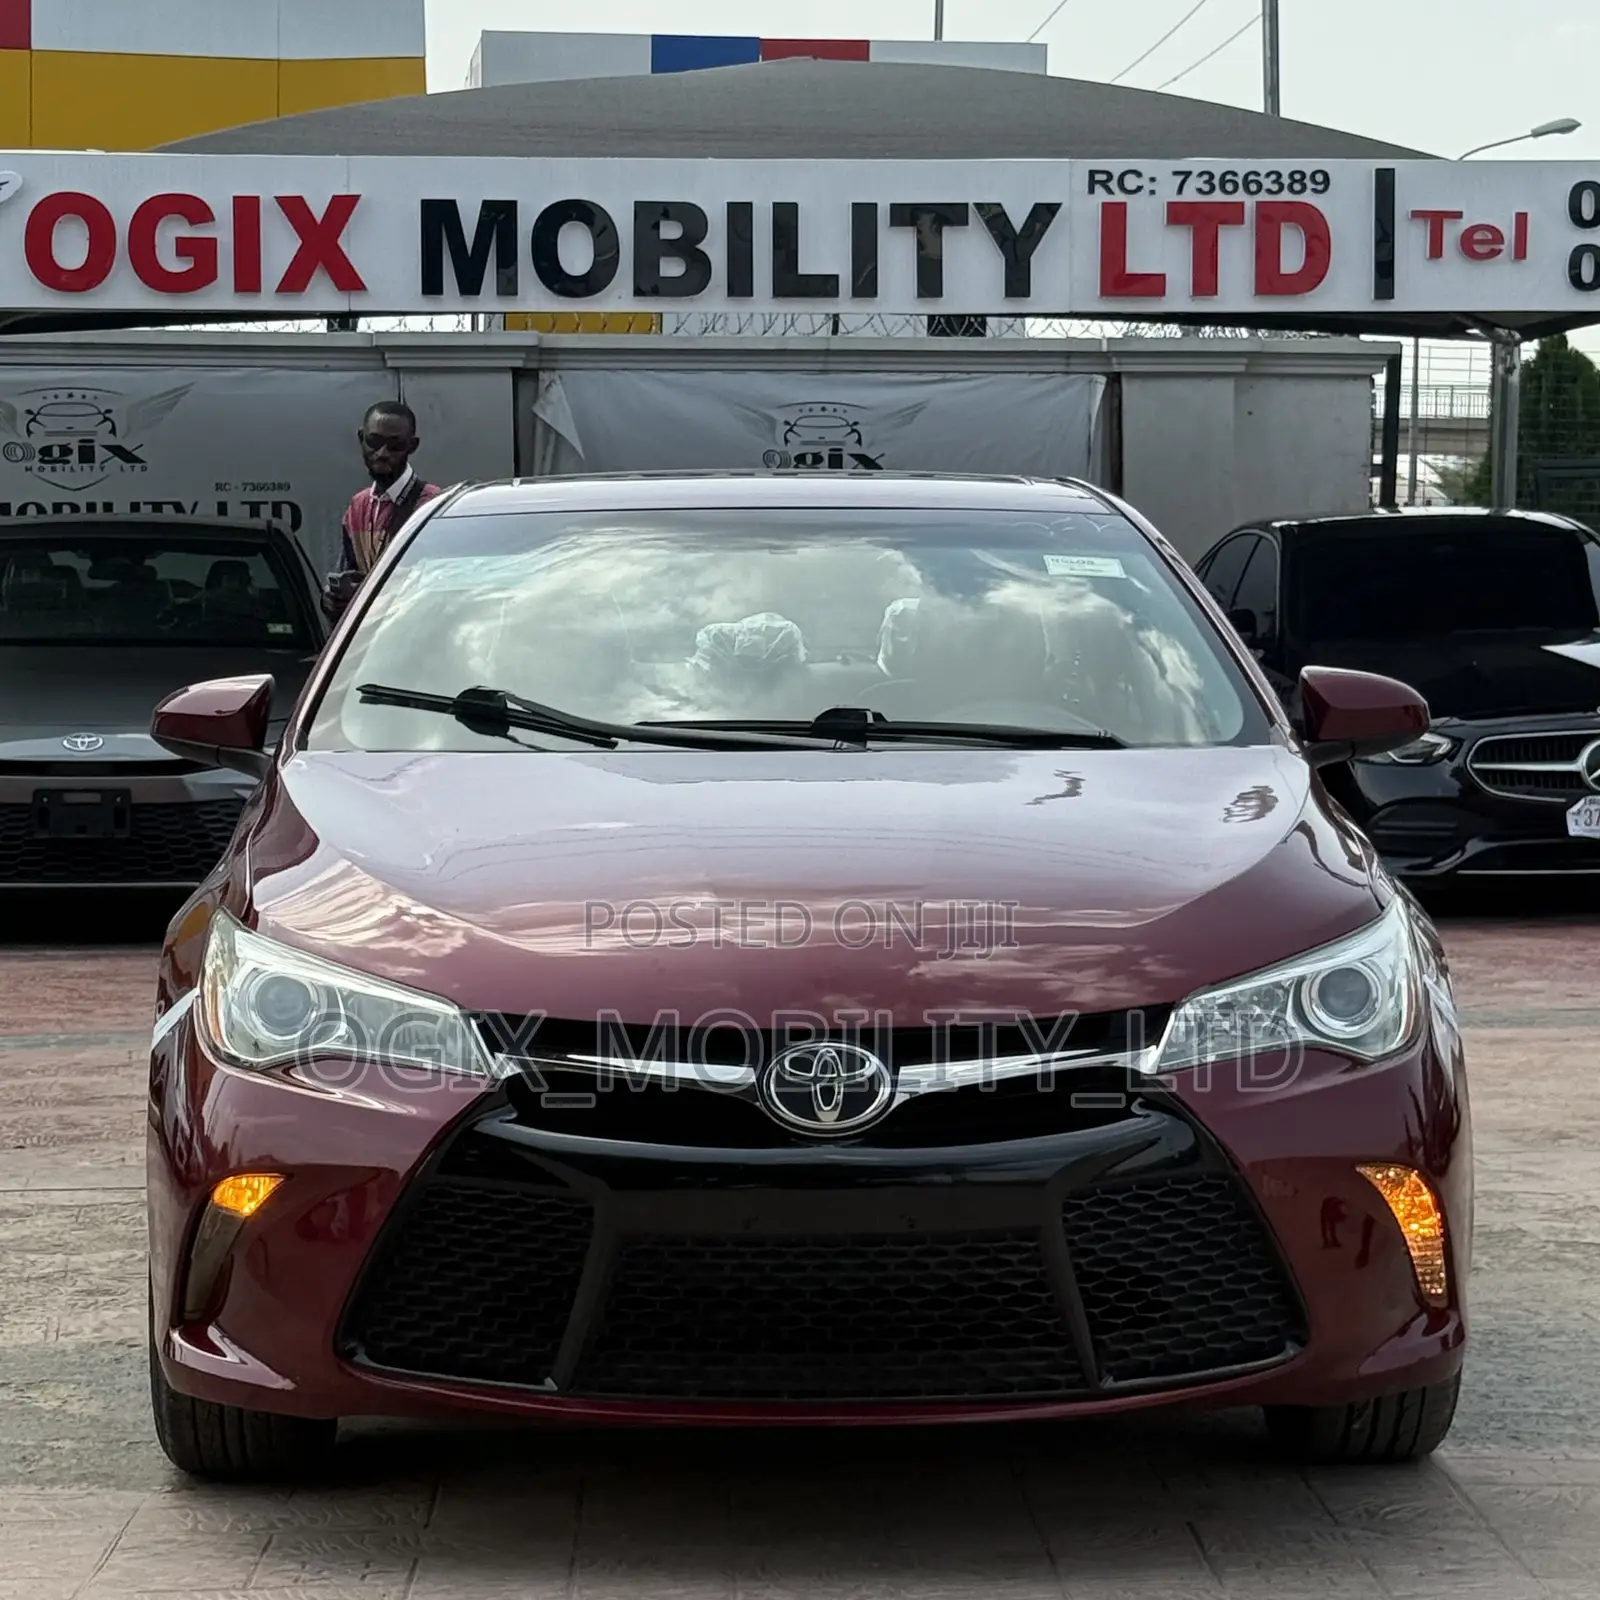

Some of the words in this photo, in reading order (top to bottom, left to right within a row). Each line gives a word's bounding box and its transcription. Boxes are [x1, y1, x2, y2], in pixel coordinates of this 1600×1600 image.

[1087, 169, 1158, 195] RC:
[1172, 169, 1331, 195] 7366389
[24, 191, 367, 294] OGIX
[421, 198, 1063, 299] MOBILITY
[1099, 200, 1331, 297] LTD
[1409, 209, 1529, 261] Tel
[214, 482, 232, 492] RC
